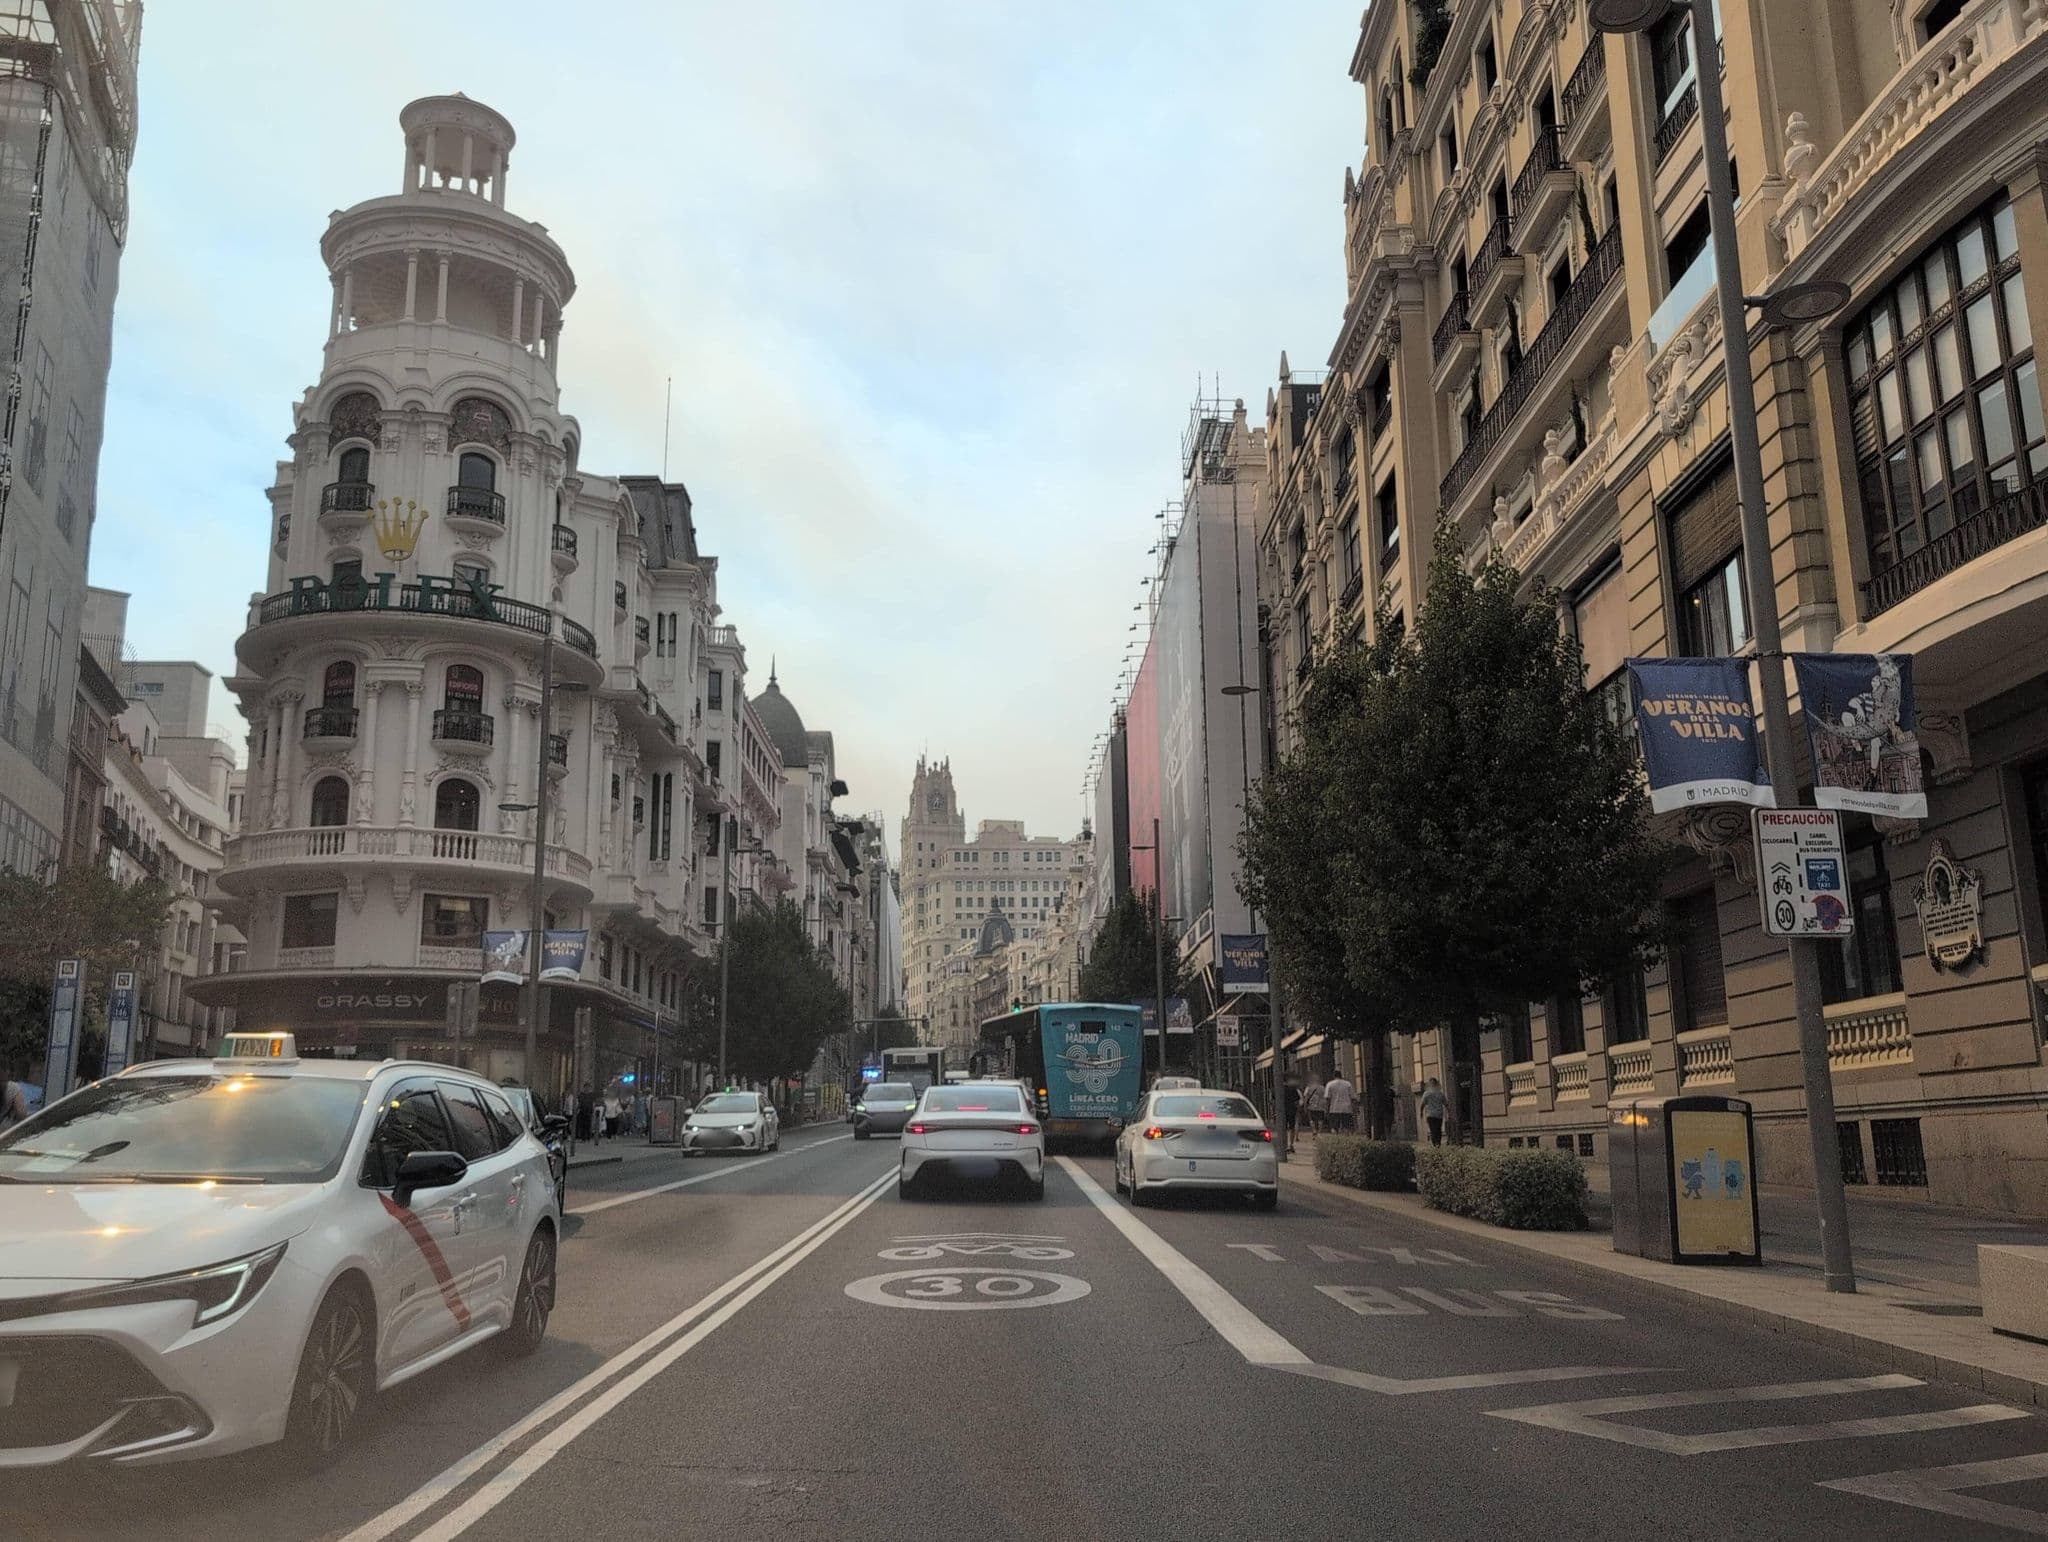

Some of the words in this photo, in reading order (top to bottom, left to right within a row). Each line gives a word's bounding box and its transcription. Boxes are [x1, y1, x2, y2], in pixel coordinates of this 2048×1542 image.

[288, 572, 504, 622] ROLEX
[1641, 699, 1751, 718] VERANOS
[1670, 719, 1745, 741] VILLA
[1702, 786, 1748, 798] MADRID
[1762, 812, 1834, 825] PRECAUCIÓN
[1779, 906, 1792, 924] 30
[317, 995, 430, 1008] GRASSY
[1065, 1032, 1099, 1044] MADRID
[237, 1038, 268, 1057] TAXI
[1069, 1093, 1094, 1103] LÍNEA
[1096, 1095, 1118, 1103] CERO
[905, 1276, 1034, 1296] 30
[1313, 1284, 1626, 1321] BUS
